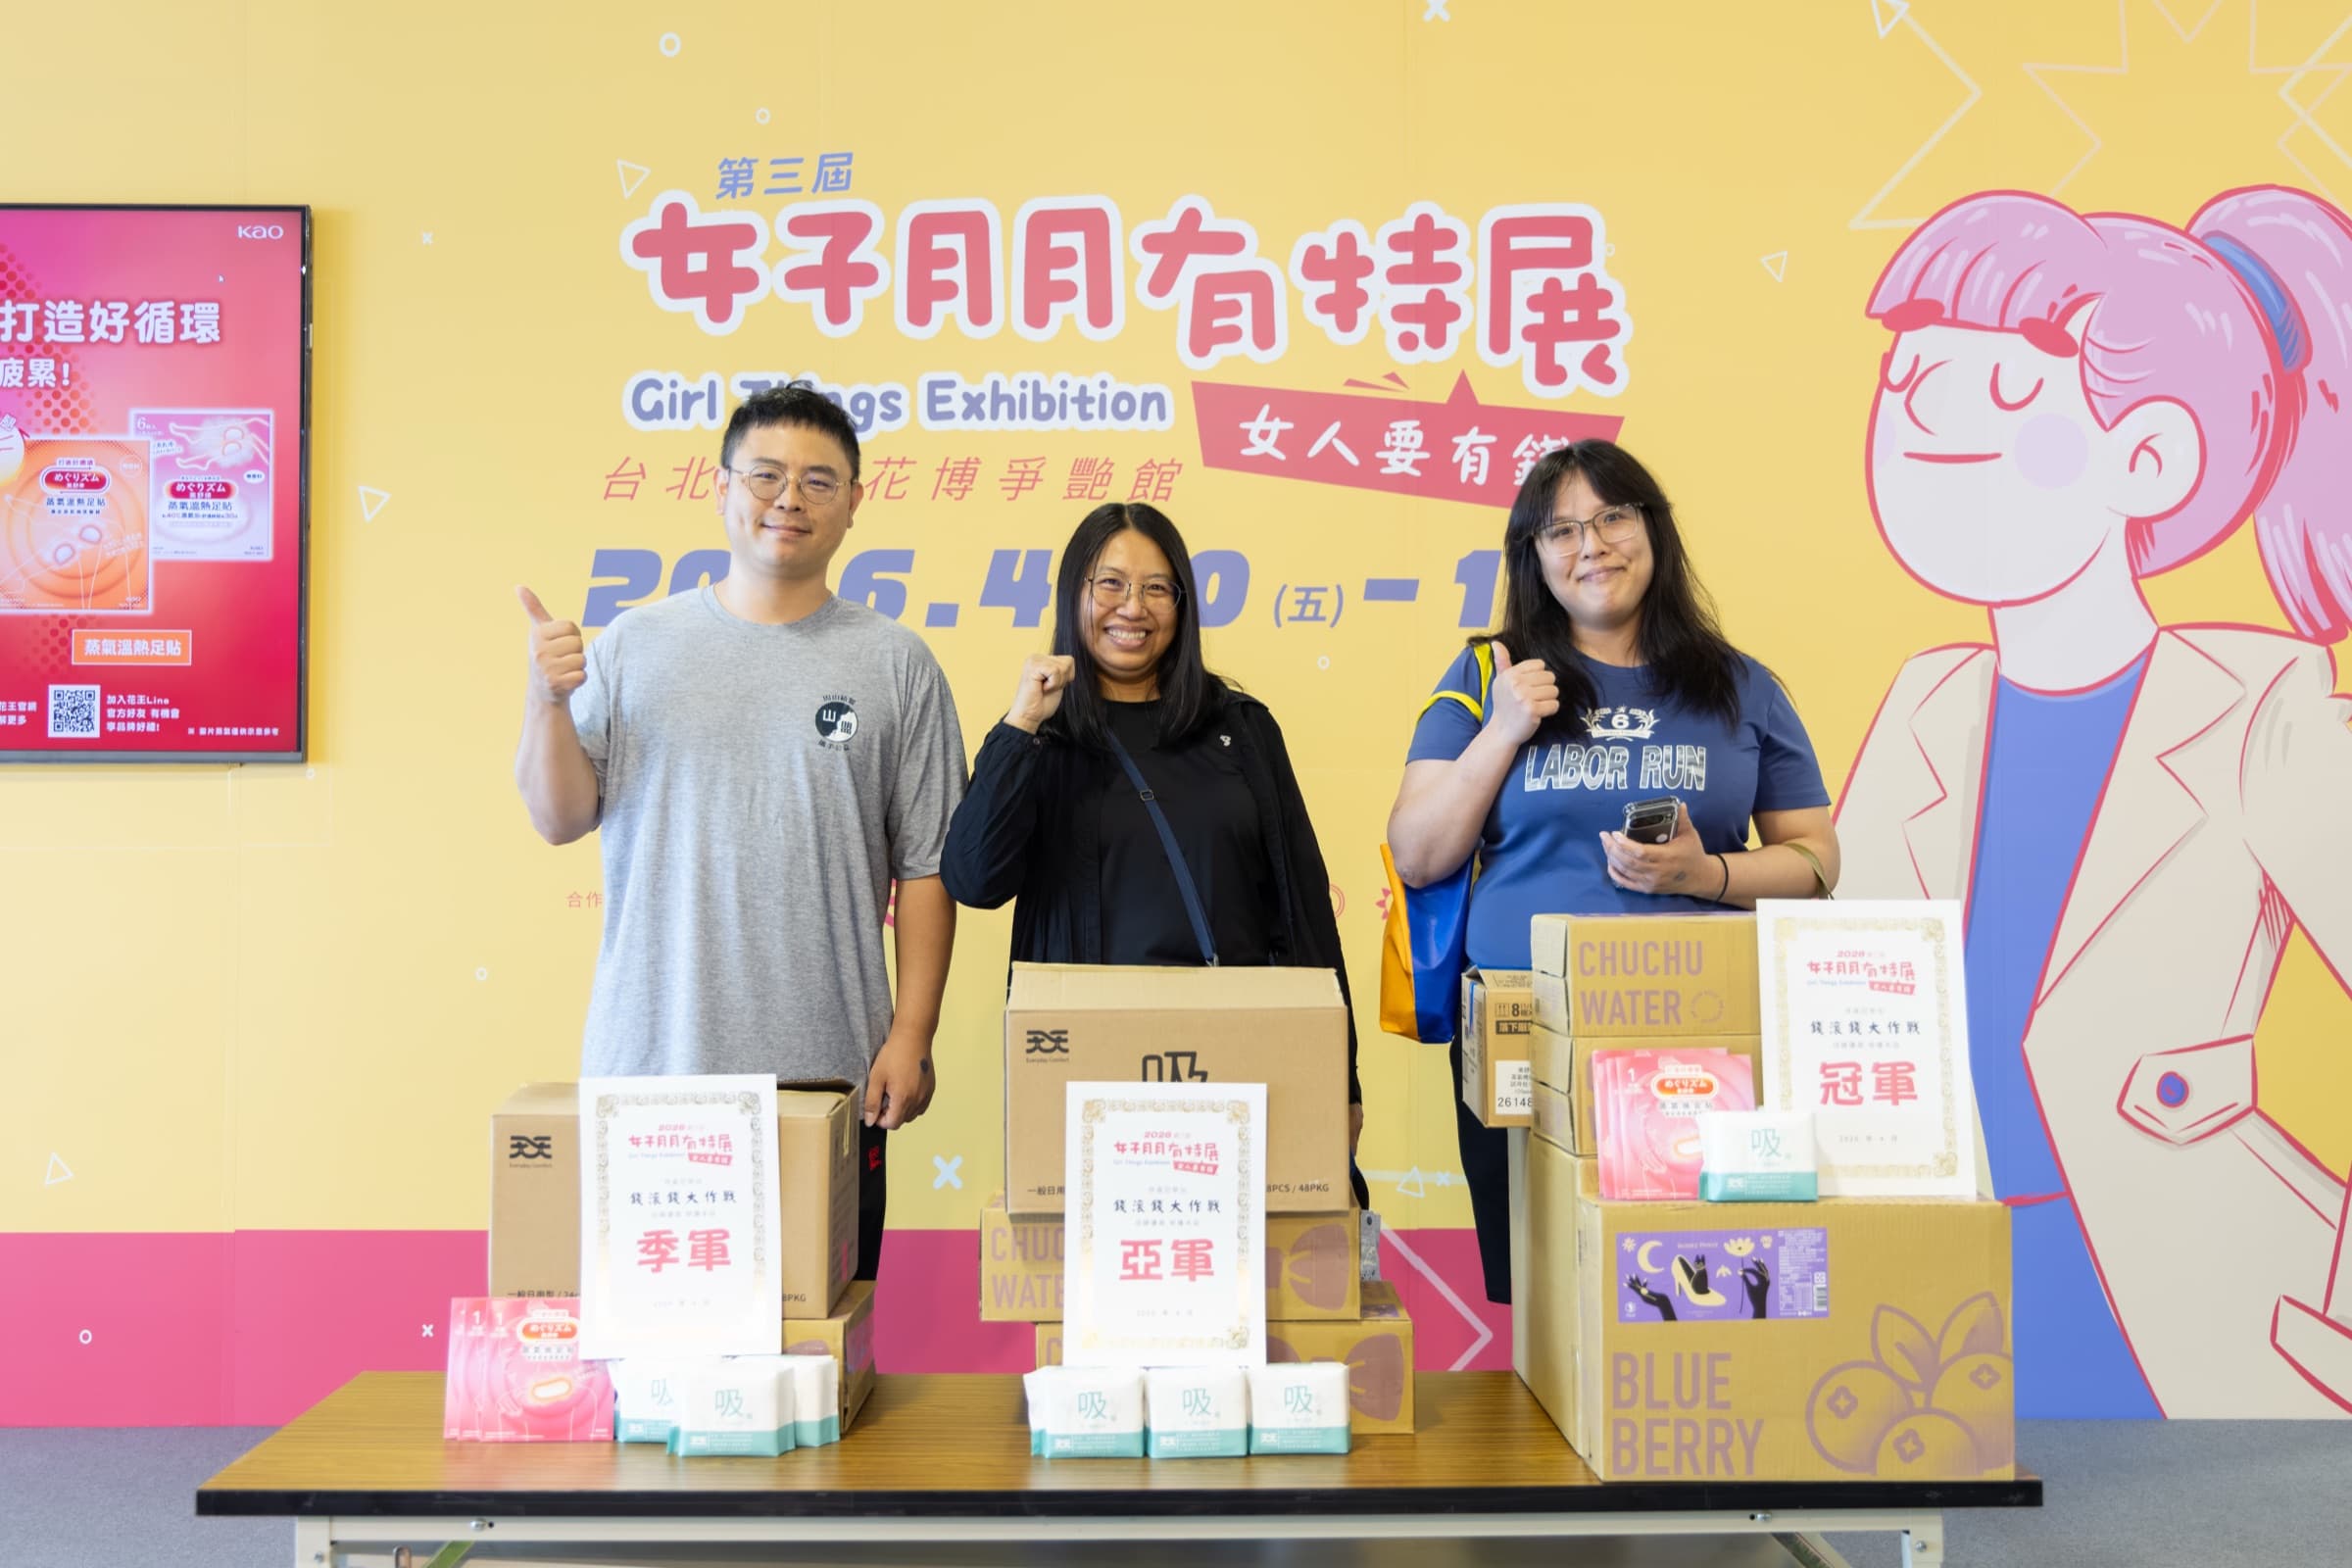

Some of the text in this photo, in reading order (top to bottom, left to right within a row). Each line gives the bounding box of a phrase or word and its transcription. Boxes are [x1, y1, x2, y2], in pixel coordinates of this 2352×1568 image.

[715, 152, 854, 200] 第三屆
[632, 201, 1621, 386] 女子月月有特展
[0, 299, 221, 344] 打造好循環
[631, 378, 717, 421] Girl
[924, 378, 1168, 422] Exhibition
[1274, 584, 1344, 628] (五)
[1454, 550, 1502, 628] 1
[1611, 713, 1630, 729] 6
[1524, 743, 1707, 793] LABOR RUN
[1578, 941, 1703, 976] CHUCHU
[1579, 989, 1682, 1026] WATER
[1819, 1060, 1918, 1106] 冠軍
[1751, 1128, 1782, 1158] 吸
[637, 1228, 732, 1272] 季軍
[992, 1227, 1065, 1262] CHUC
[1119, 1239, 1215, 1283] 亞軍
[993, 1272, 1065, 1309] WATE
[714, 1389, 744, 1417] 吸
[1183, 1388, 1211, 1416] 吸
[1284, 1385, 1313, 1414] 吸
[1612, 1352, 1732, 1410] BLUE
[1077, 1391, 1106, 1419] 吸
[1612, 1418, 1764, 1476] BERRY
